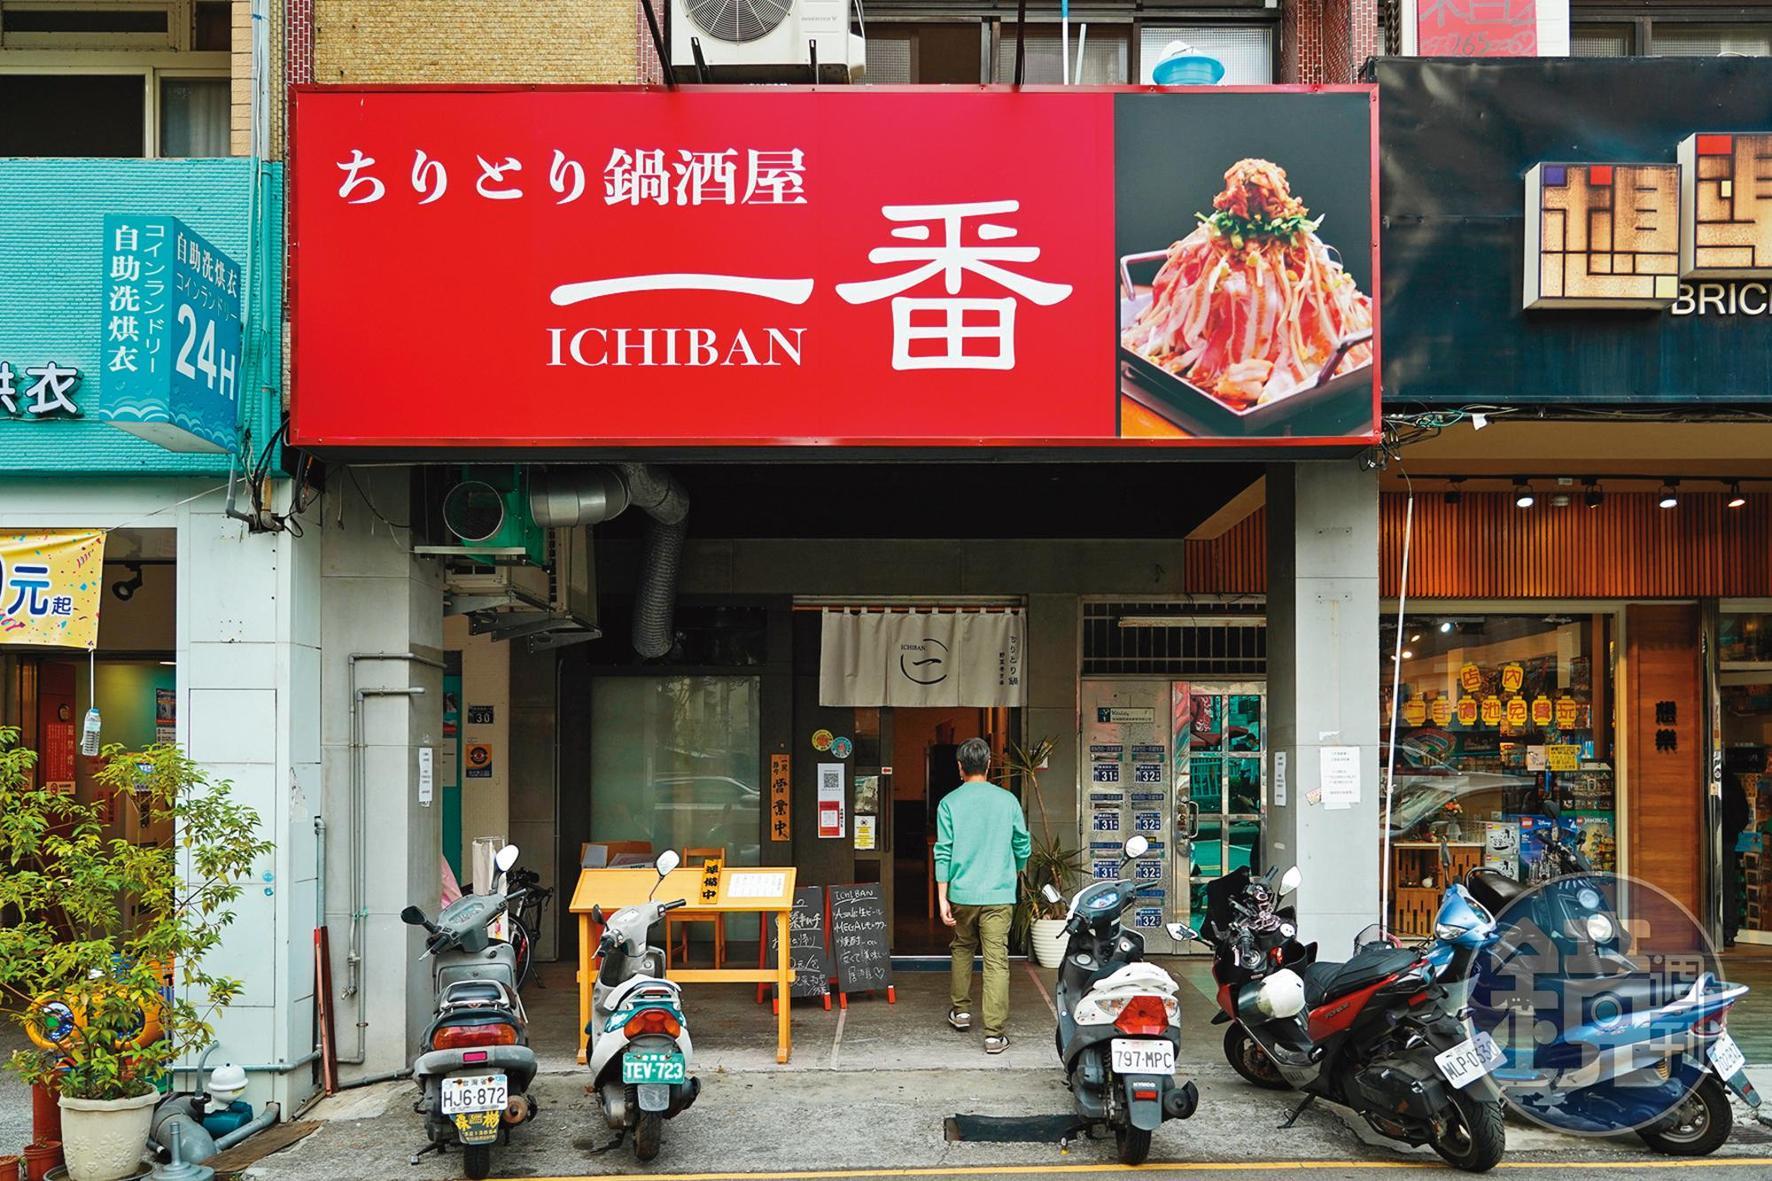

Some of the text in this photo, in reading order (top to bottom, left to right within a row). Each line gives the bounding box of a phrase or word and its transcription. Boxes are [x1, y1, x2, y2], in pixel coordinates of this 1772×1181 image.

[336, 146, 808, 206] ちりとり鍋酒屋
[177, 231, 238, 299] 自助洗烘衣
[107, 224, 141, 373] 自助洗烘衣
[143, 223, 166, 374] コインランドリー
[550, 199, 1074, 371] 一番
[1671, 282, 1772, 316] BRIC
[175, 303, 236, 401] 24H
[545, 327, 808, 367] ICHIBAN
[0, 558, 72, 616] 元起
[1101, 771, 1113, 781] 31
[1142, 771, 1156, 782] 32
[1101, 820, 1113, 830] 31
[1142, 820, 1156, 830] 32
[1101, 868, 1113, 878] 31
[1142, 868, 1156, 878] 32
[1142, 916, 1156, 926] 32
[443, 1087, 506, 1107] HJ6-872
